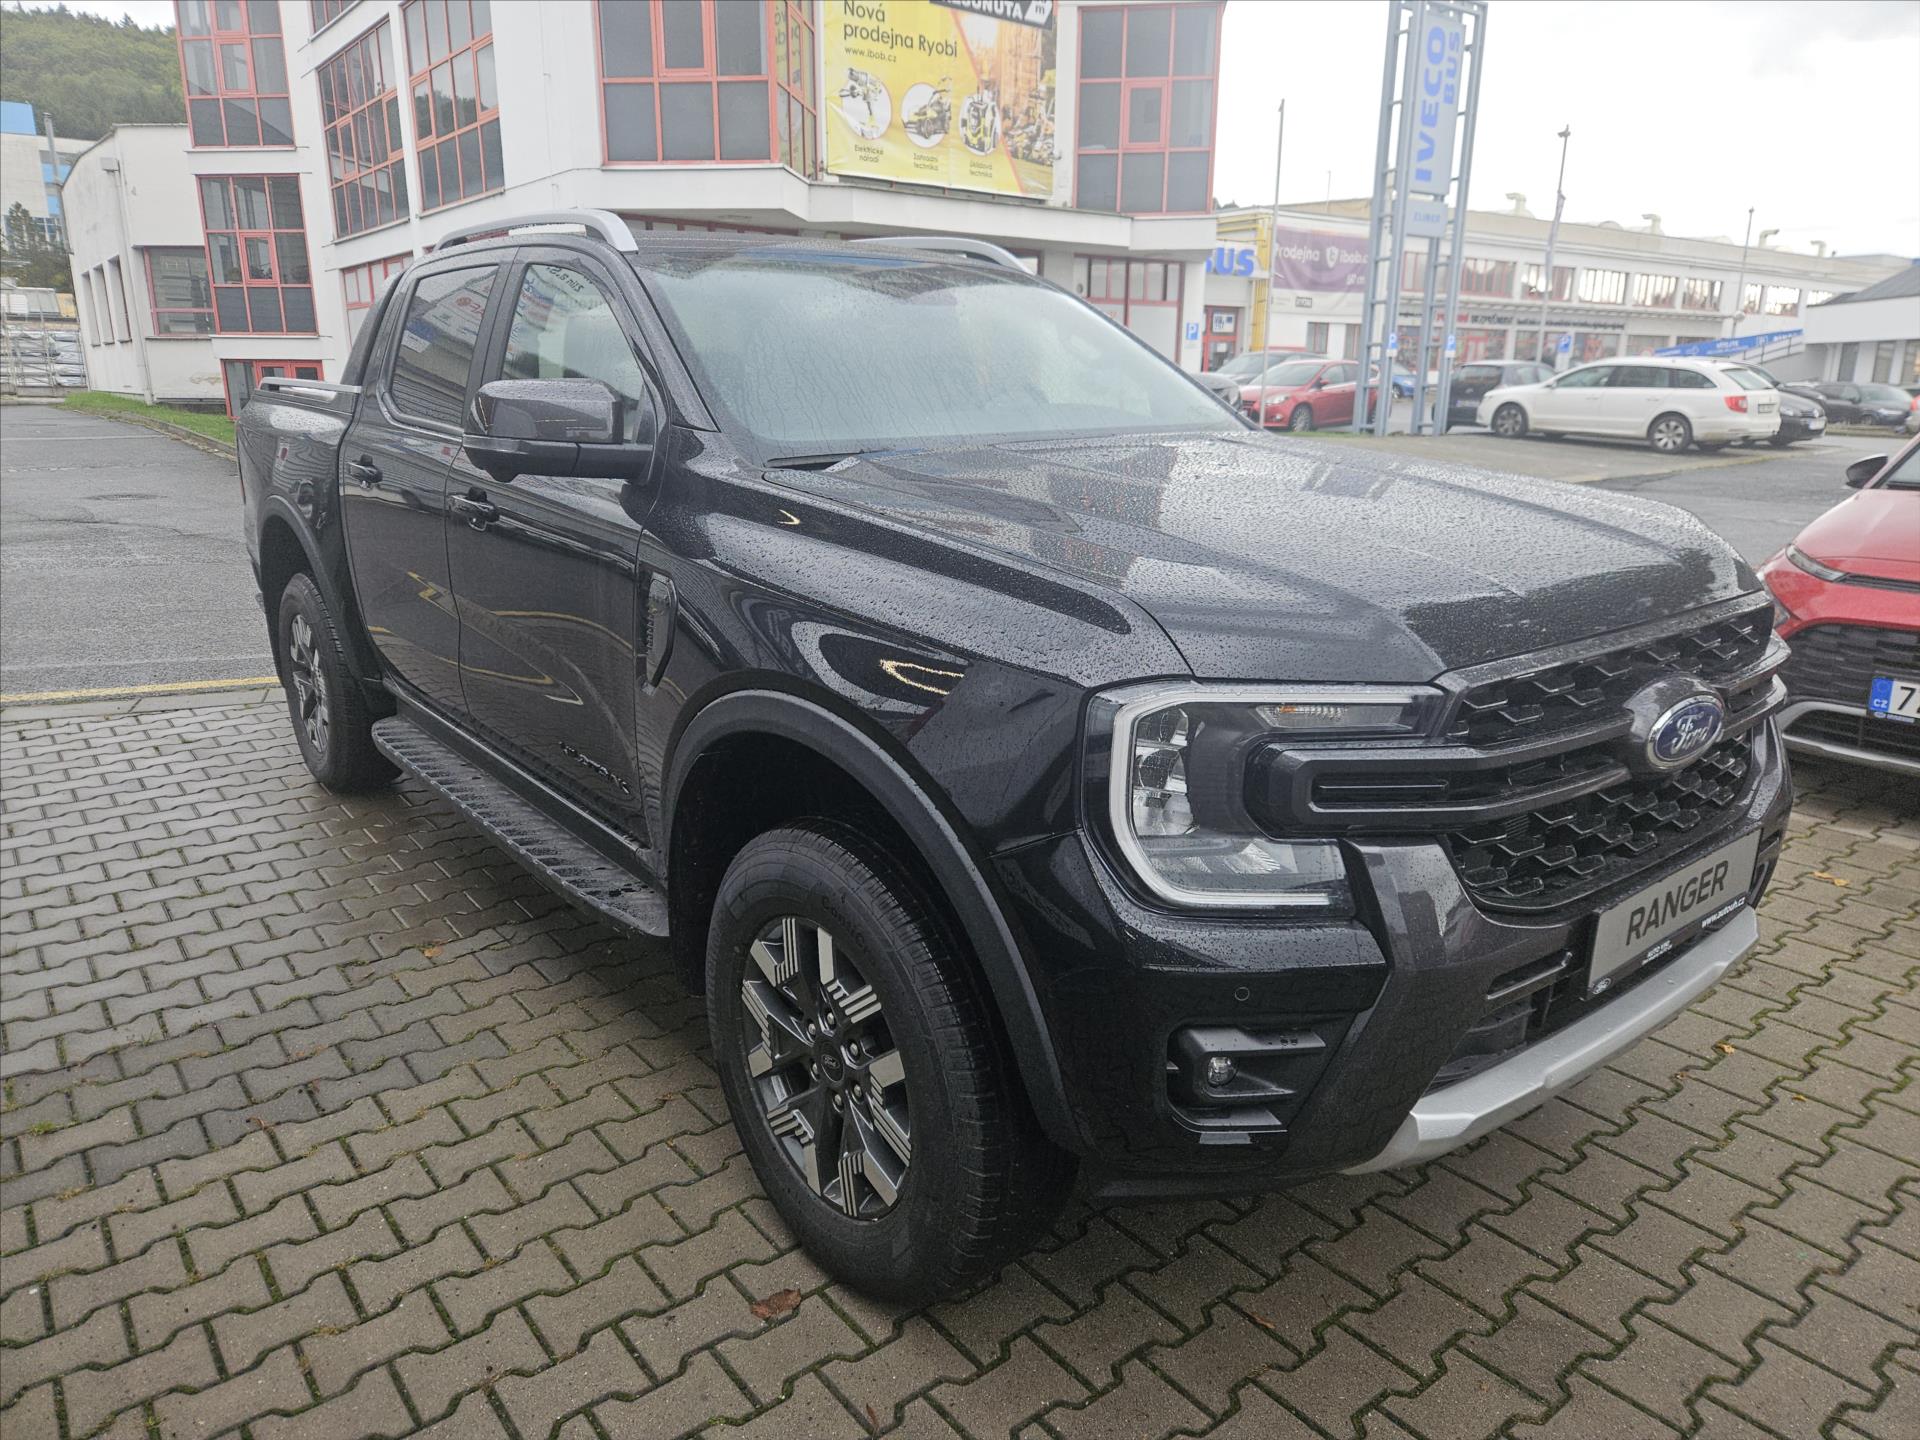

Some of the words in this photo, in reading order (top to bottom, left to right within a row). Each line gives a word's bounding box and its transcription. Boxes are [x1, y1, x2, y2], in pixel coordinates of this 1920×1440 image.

[843, 0, 885, 22] Nová
[843, 23, 914, 49] prodejna
[919, 34, 957, 57] Ryobi
[844, 46, 897, 62] www.ibob.cz
[1443, 31, 1461, 105] BUS
[1414, 26, 1446, 182] IVECO
[1339, 251, 1369, 264] ibob.c
[1873, 698, 1889, 710] CZ
[1899, 685, 1920, 714] 7
[1671, 711, 1714, 755] Ford
[1626, 860, 1729, 946] RANGER
